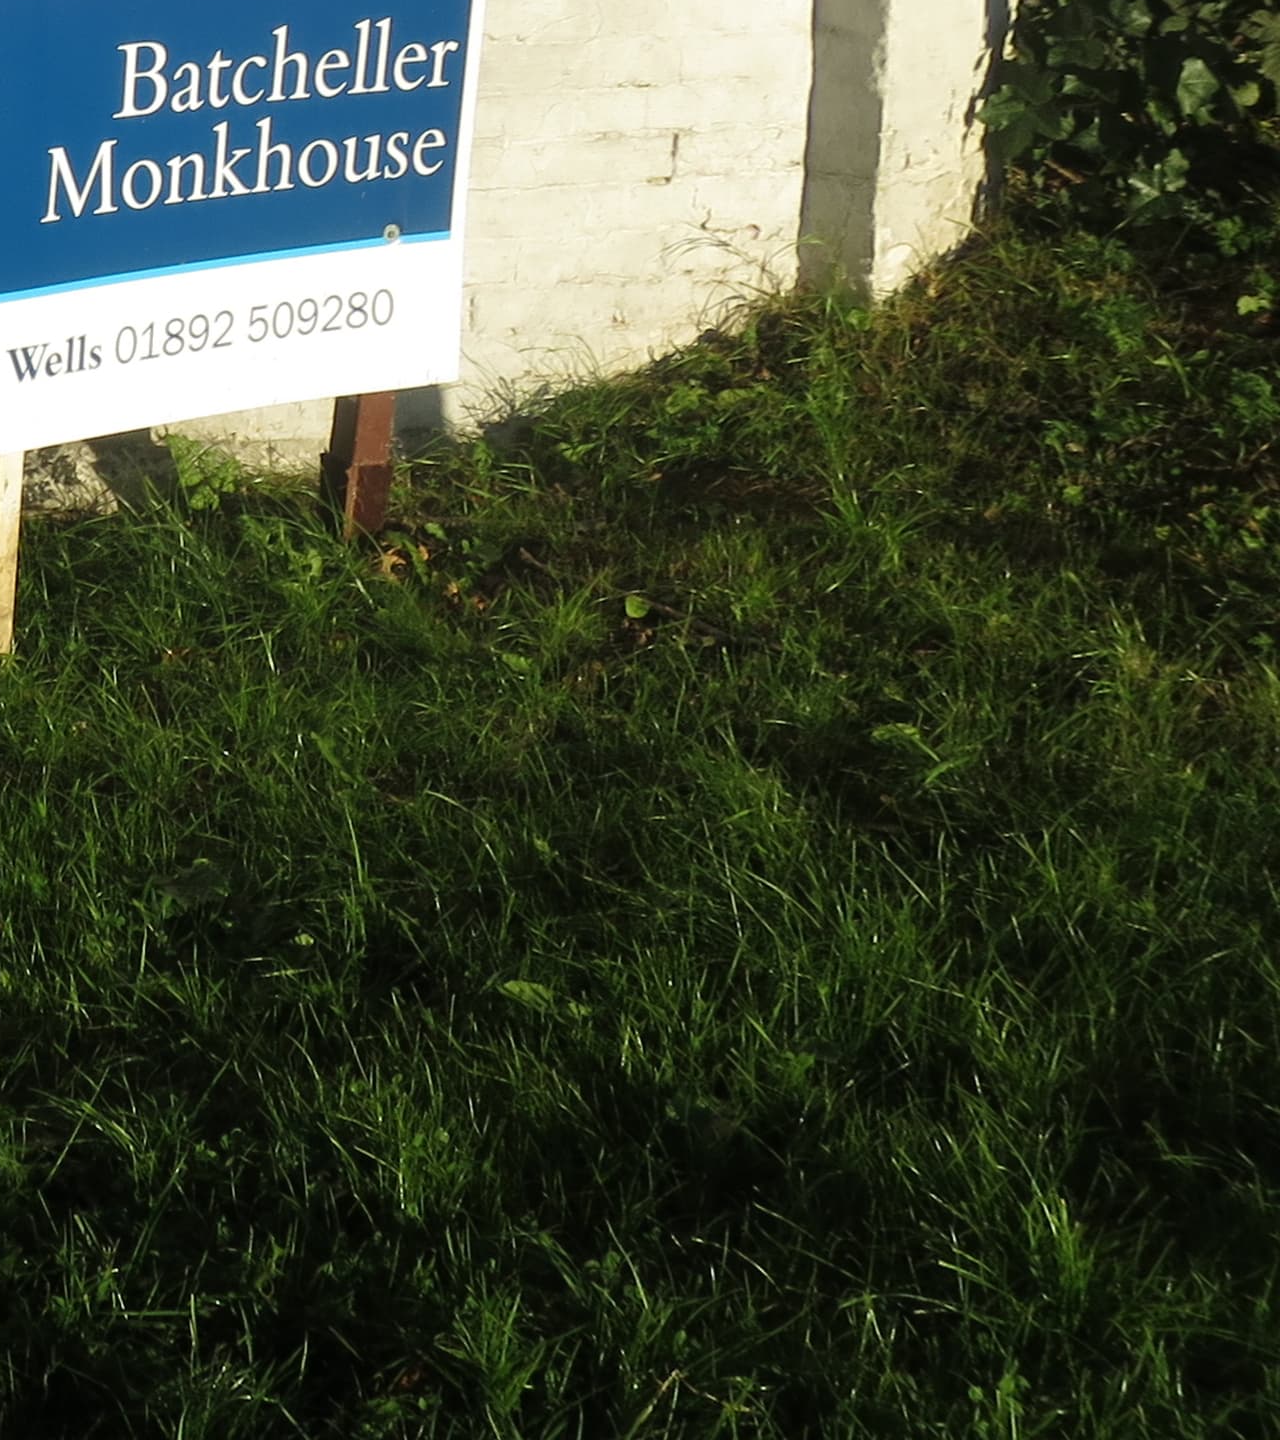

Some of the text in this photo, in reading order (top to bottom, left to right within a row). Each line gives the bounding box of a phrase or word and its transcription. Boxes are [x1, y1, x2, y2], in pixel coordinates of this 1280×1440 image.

[112, 17, 458, 121] Batcheller
[40, 116, 447, 224] Monkhouse
[6, 335, 102, 382] Wells
[115, 306, 233, 366] 01892
[247, 288, 394, 344] 509280
